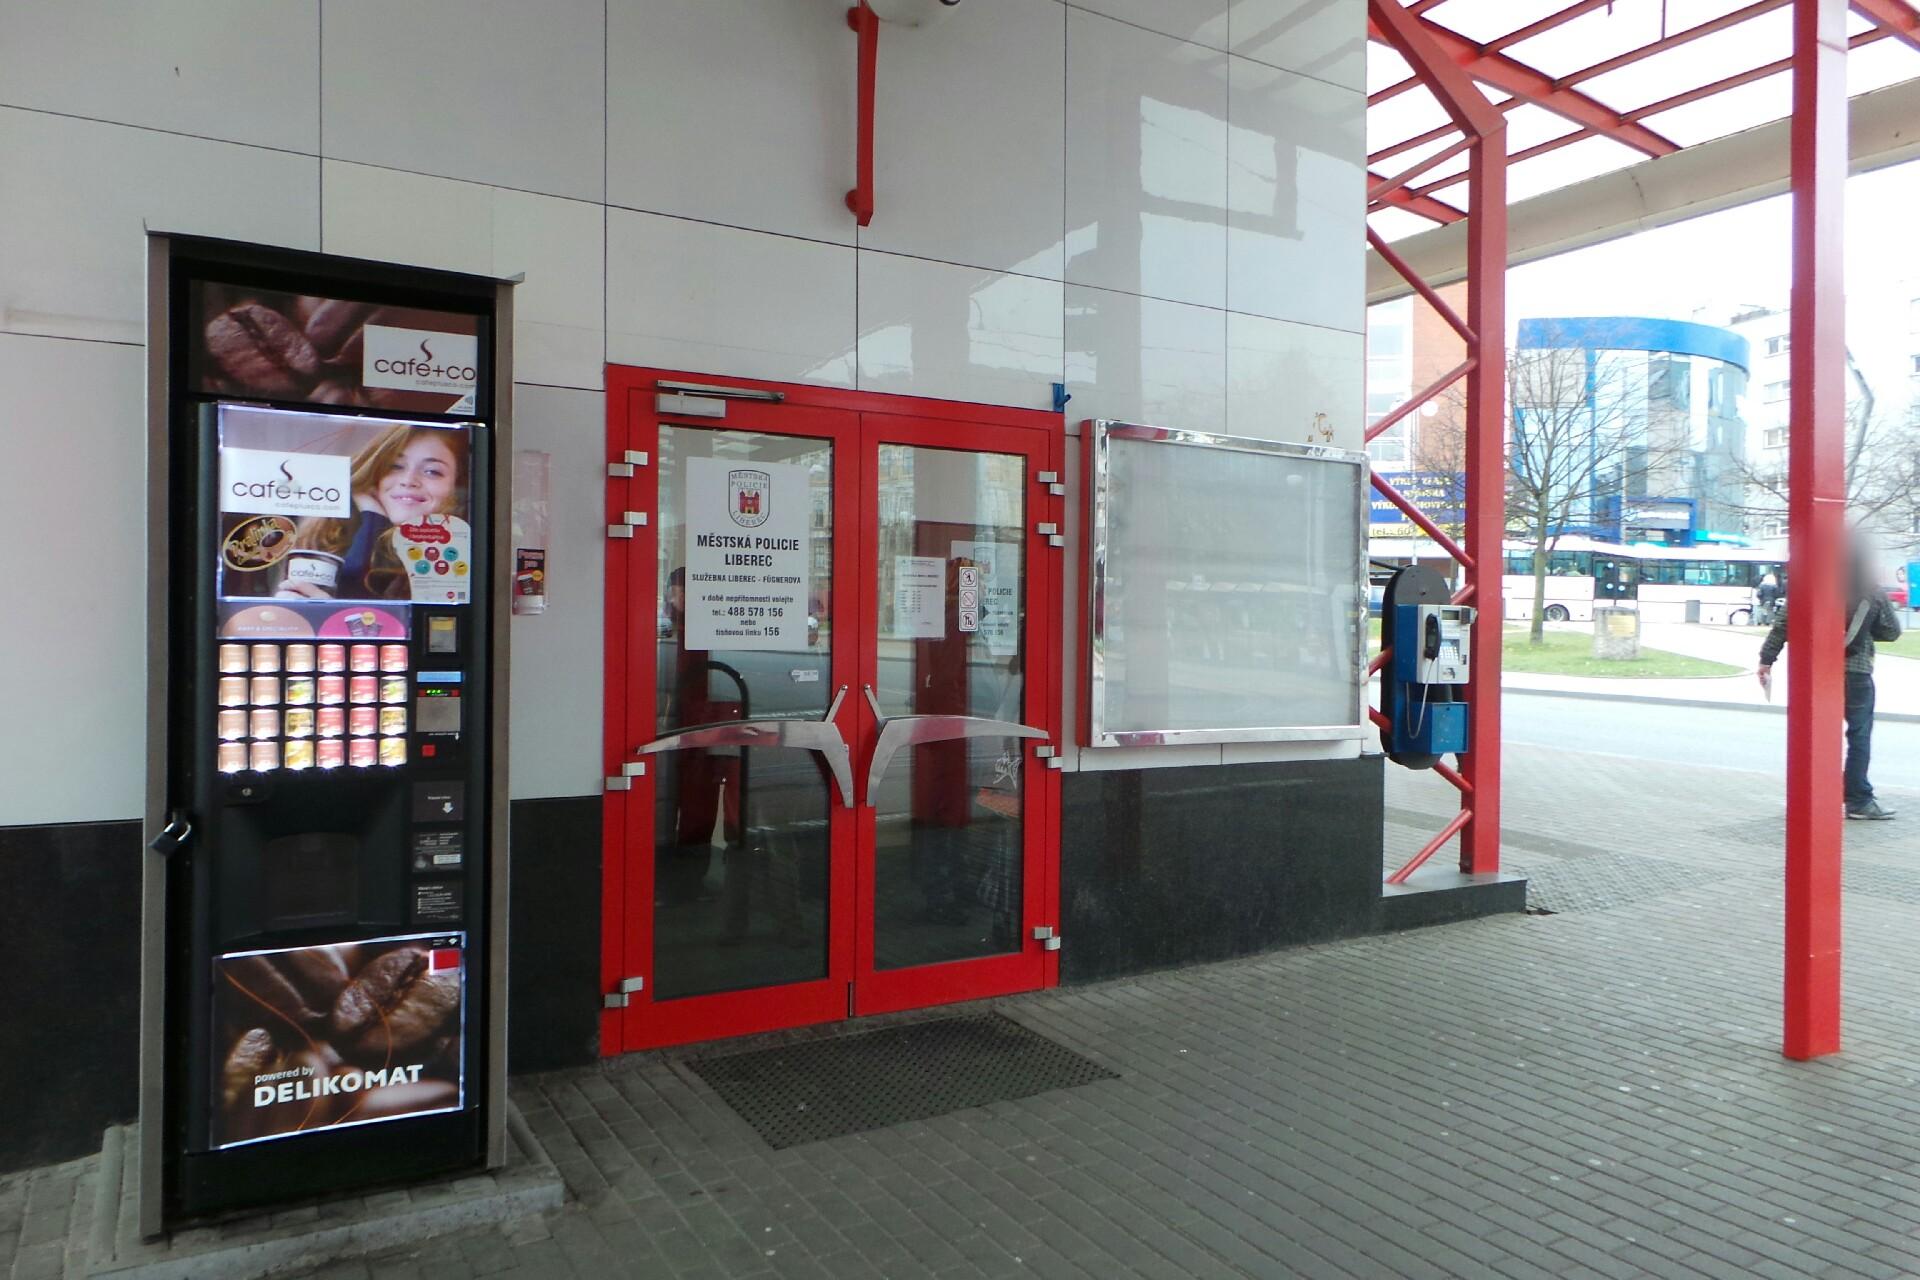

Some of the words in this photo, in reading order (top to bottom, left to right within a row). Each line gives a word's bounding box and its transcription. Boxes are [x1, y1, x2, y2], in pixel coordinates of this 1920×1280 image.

[731, 481, 768, 489] POLICIE
[732, 510, 766, 525] LIBEREC
[697, 533, 752, 549] MĚSTSKÁ
[756, 537, 799, 551] POLICIE
[725, 554, 773, 567] LIBEREC
[692, 572, 727, 582] SLUŽEBNA
[728, 574, 756, 583] LIBEREC
[707, 594, 724, 602] době
[772, 596, 794, 605] volejte
[727, 607, 745, 616] 488
[747, 607, 764, 616] 578
[768, 607, 783, 617] 156
[740, 618, 756, 626] nebo
[745, 628, 761, 636] linku
[764, 627, 780, 637] 156
[254, 1067, 299, 1085] powered
[302, 1065, 316, 1077] by
[254, 1064, 424, 1108] DELIKOMAT
